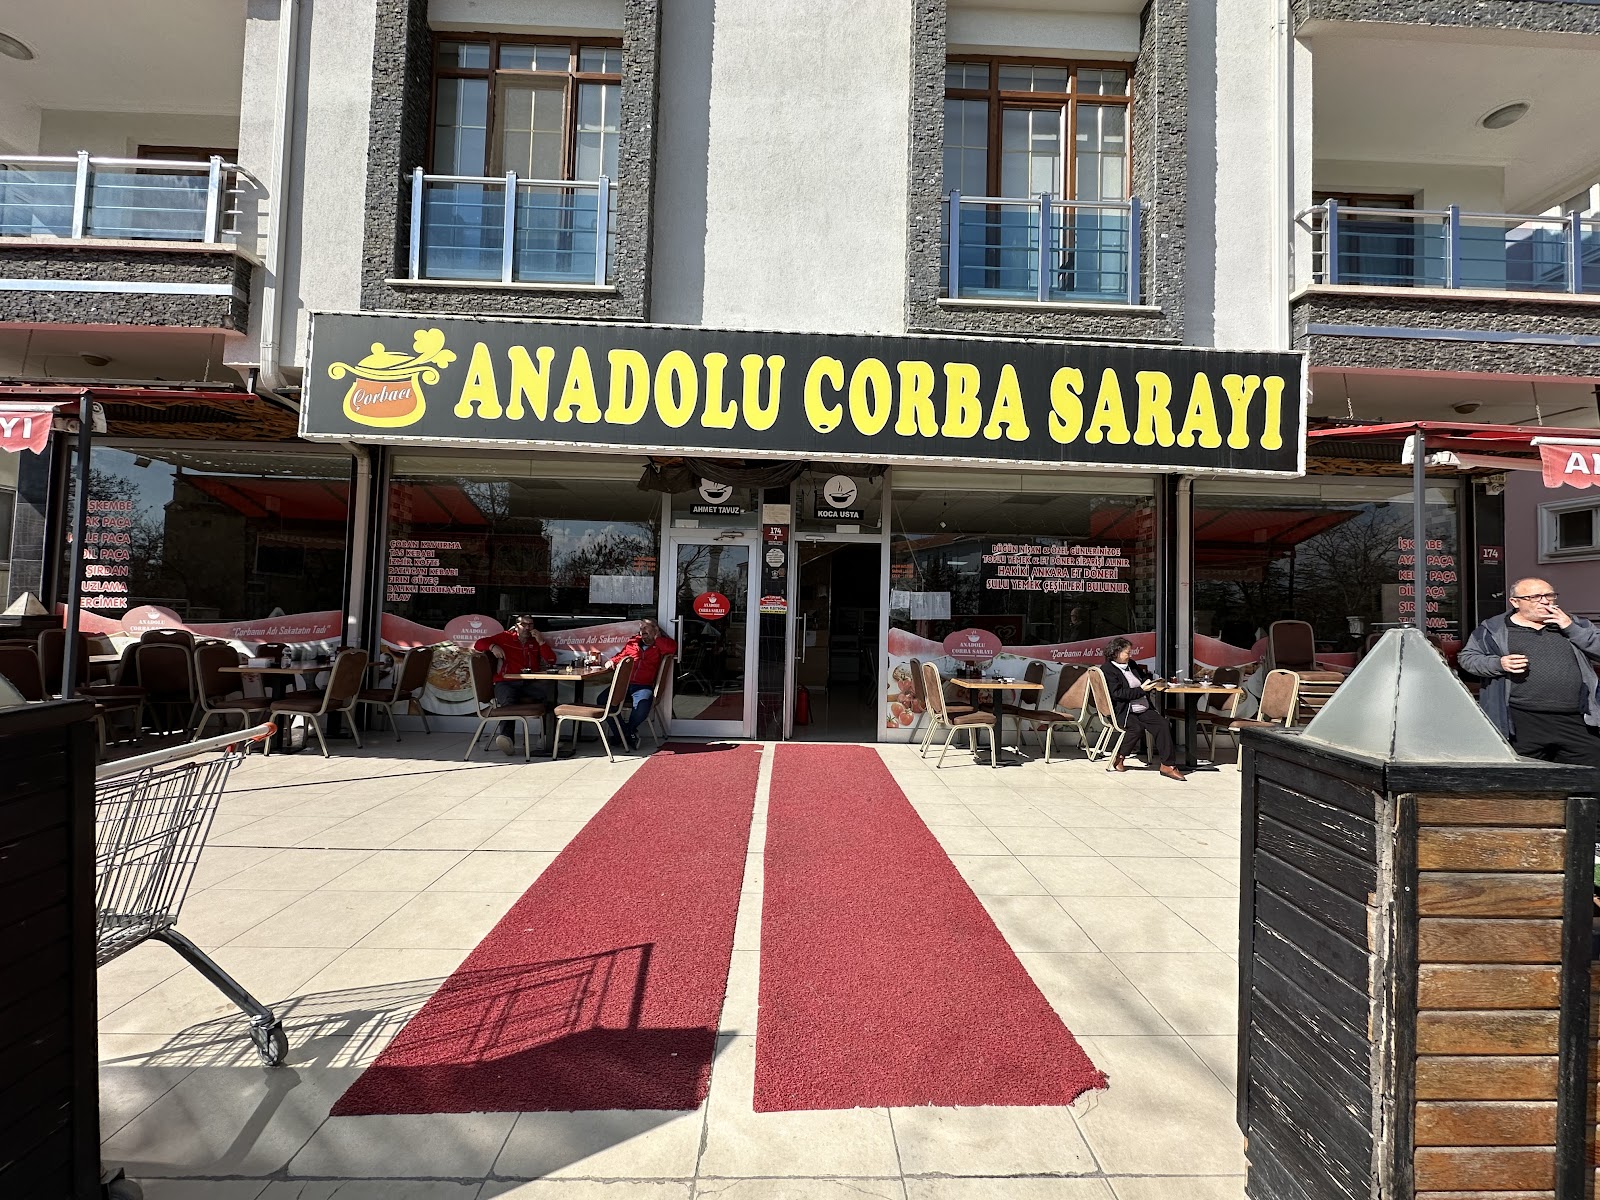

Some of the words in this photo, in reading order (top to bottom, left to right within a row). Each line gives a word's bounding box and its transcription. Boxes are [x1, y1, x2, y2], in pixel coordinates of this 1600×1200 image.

[454, 342, 786, 431] ANADOLU
[1048, 366, 1285, 451] SARAYI
[87, 498, 132, 513] ŞKEMBE
[692, 505, 717, 513] AHMET
[817, 510, 838, 518] KOCA
[839, 511, 859, 519] USTA
[102, 517, 132, 529] PAÇA
[102, 533, 131, 546] PAÇA
[389, 540, 419, 548] ÇOBAN
[420, 541, 462, 549] KAVURMA
[101, 549, 130, 562] PAÇA
[389, 549, 404, 557] TAS
[405, 549, 435, 557] KEBABI
[1483, 548, 1498, 558] 174
[982, 555, 1006, 564] TOPLU
[1007, 556, 1032, 565] YEMEK
[1050, 555, 1076, 565] DÖNER
[1427, 555, 1454, 567] PAÇA
[85, 564, 129, 577] ŞIRDAN
[998, 564, 1029, 576] HAKİKİ
[1031, 567, 1069, 578] ANKARA
[1071, 568, 1082, 578] ET
[1084, 567, 1118, 579] DÖNERİ
[1430, 571, 1457, 583] PAÇA
[80, 580, 128, 592] UZLAMA
[986, 579, 1009, 589] SULU
[1010, 579, 1042, 590] YEMEK
[1086, 582, 1130, 593] BULUNUR
[1426, 586, 1445, 598] AÇA
[80, 594, 127, 608] ERCİMEK
